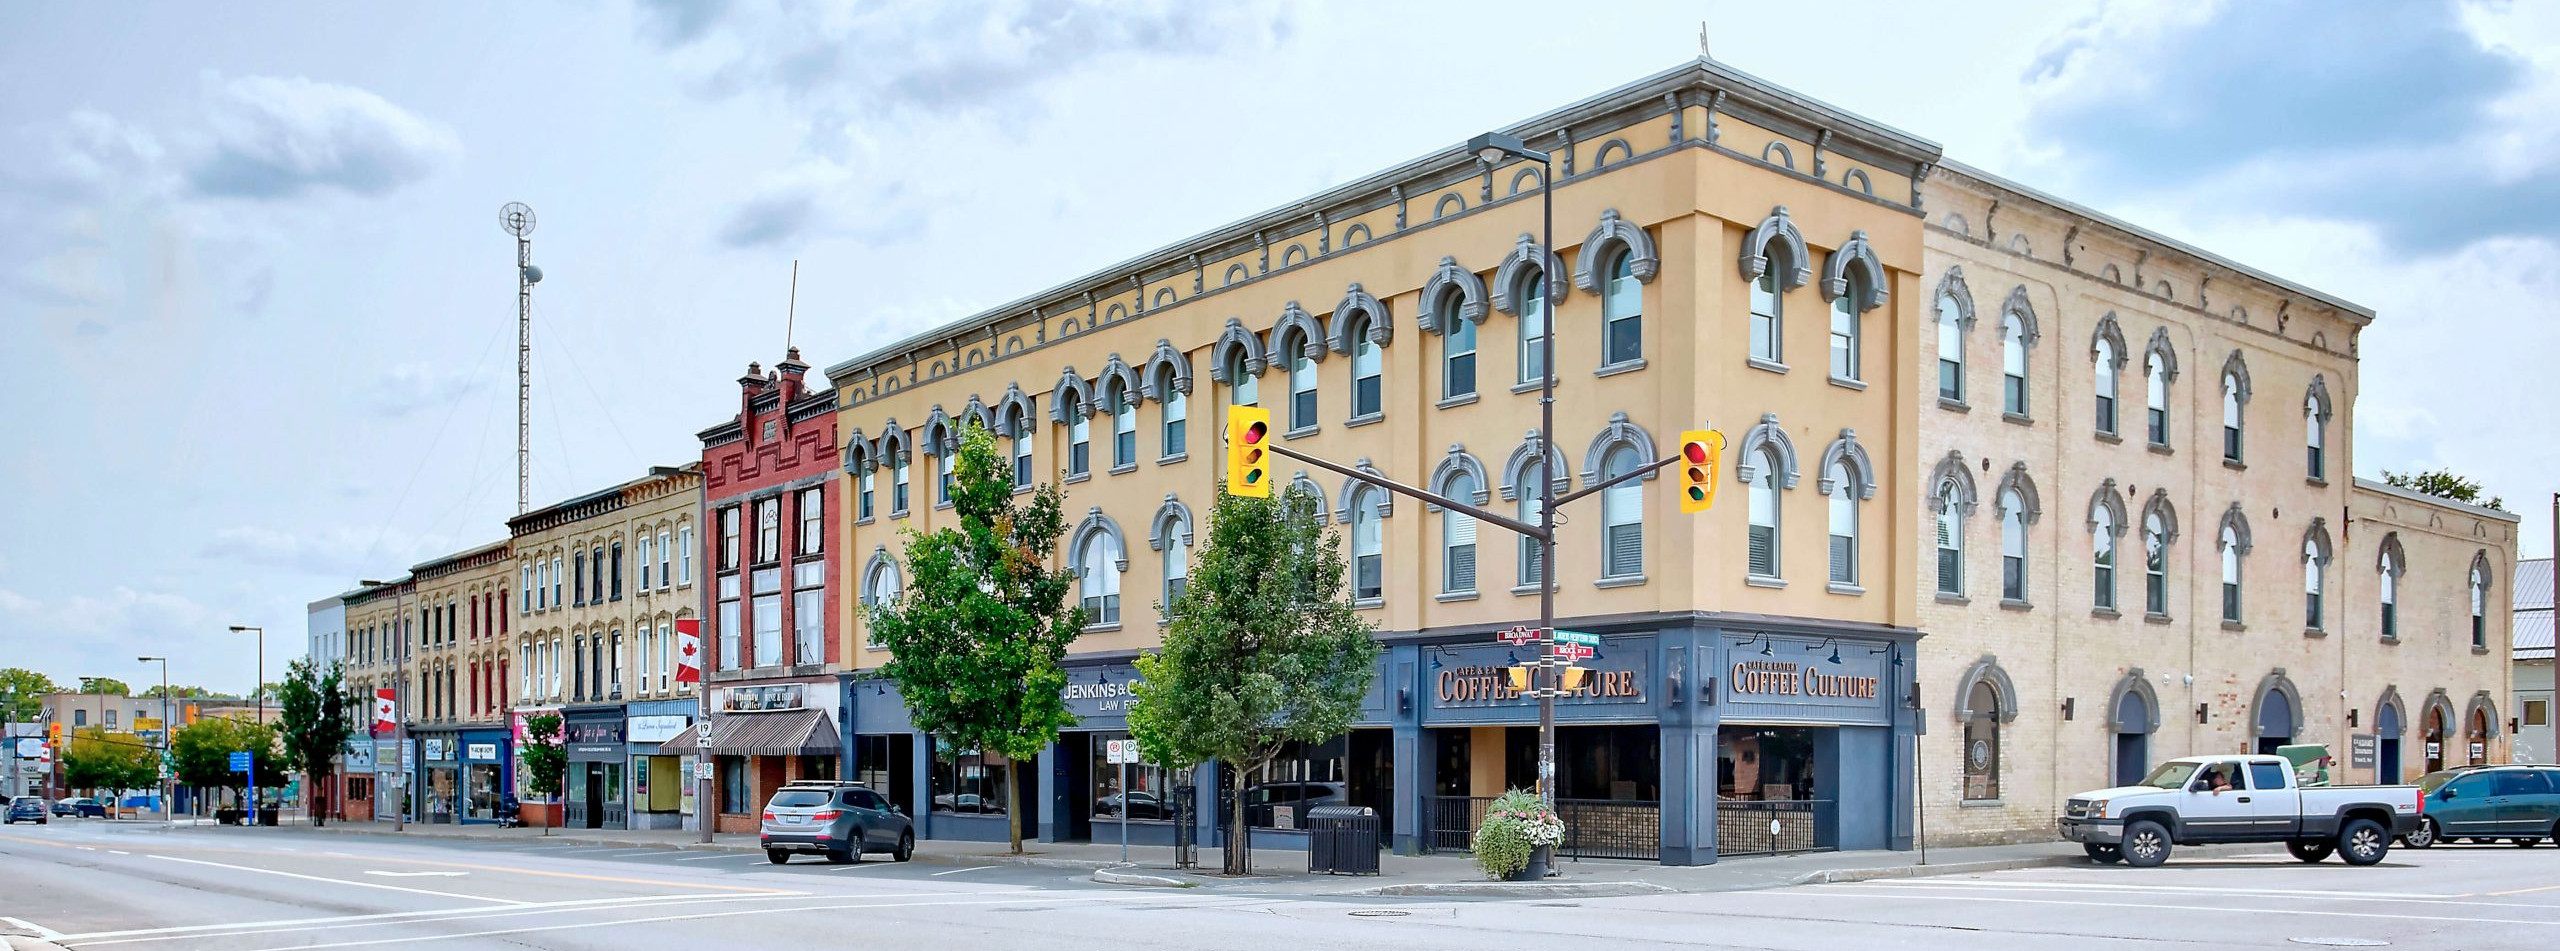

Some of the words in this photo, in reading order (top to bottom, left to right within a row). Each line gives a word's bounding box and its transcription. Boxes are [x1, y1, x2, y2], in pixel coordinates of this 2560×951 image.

[1504, 631, 1534, 639] BROADWAY
[1455, 664, 1476, 675] CAFÉ
[1477, 667, 1484, 675] &
[1733, 662, 1800, 694] COFFEE
[1804, 666, 1877, 698] CULTURE
[1064, 683, 1116, 699] JENKINS
[1118, 684, 1126, 695] &
[1100, 701, 1119, 710] LAW
[700, 723, 709, 732] 19
